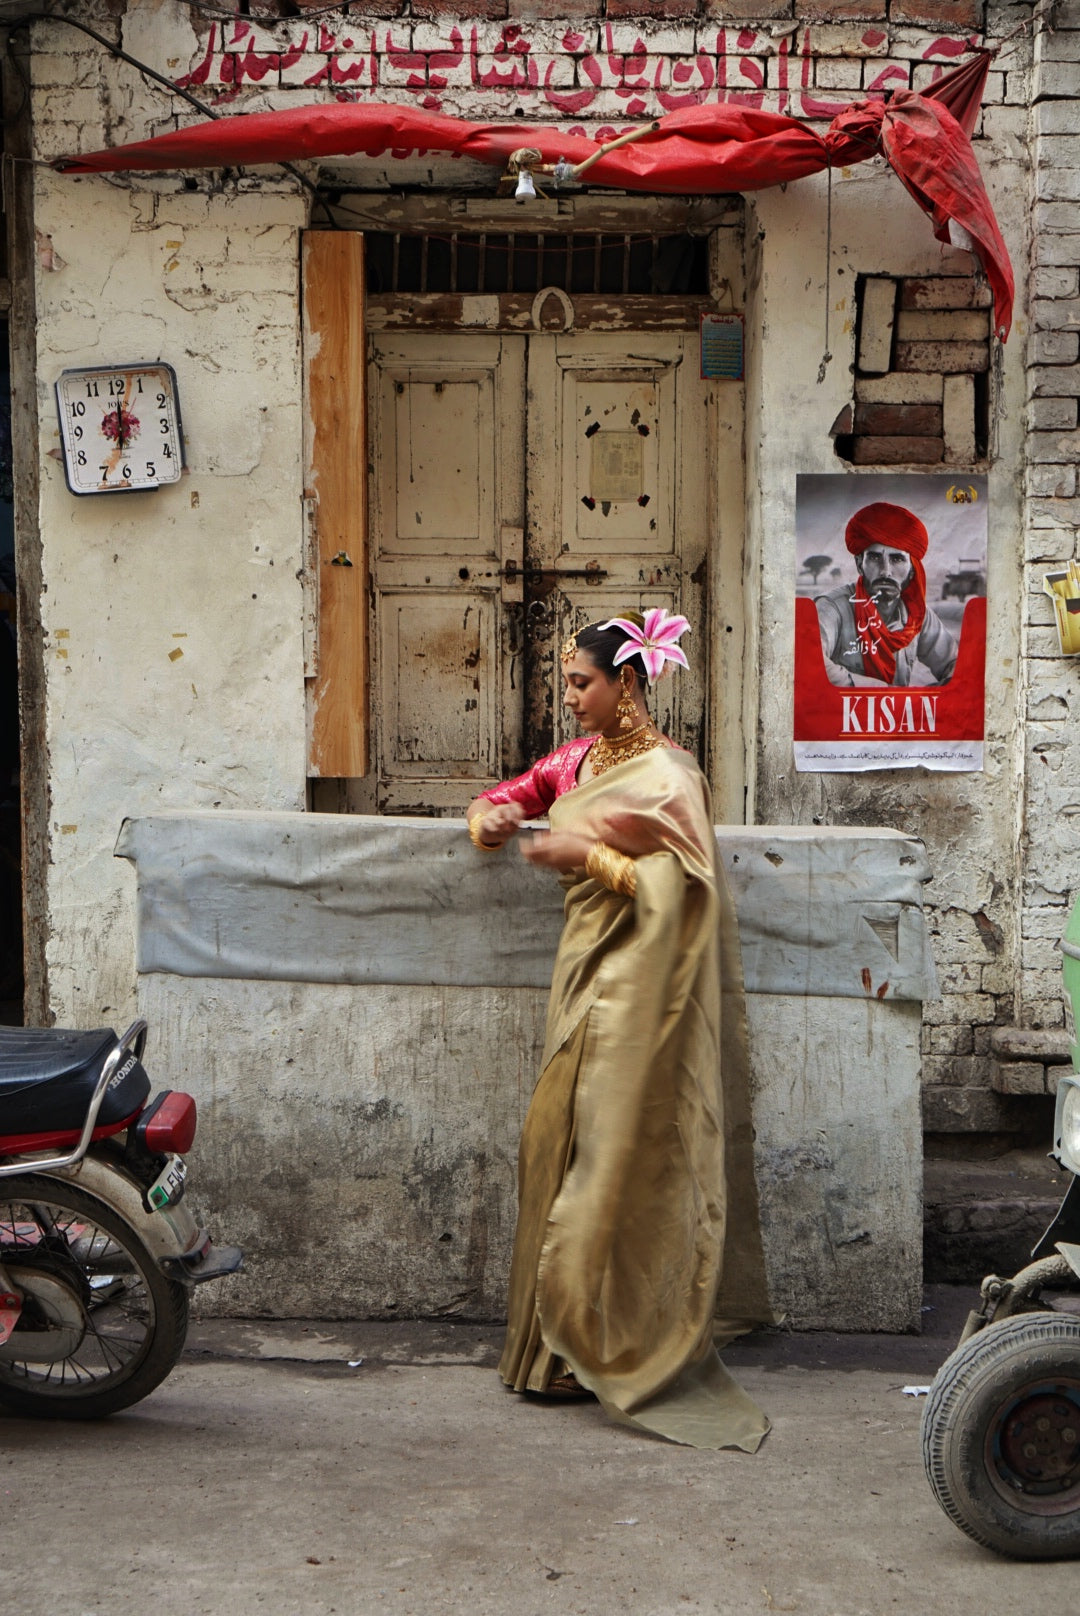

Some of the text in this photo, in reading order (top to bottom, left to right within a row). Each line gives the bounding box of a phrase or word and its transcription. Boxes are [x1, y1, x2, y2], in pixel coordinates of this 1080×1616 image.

[385, 24, 541, 111] شاپ
[86, 381, 99, 398] 11
[108, 379, 125, 396] 12
[136, 378, 144, 394] 1
[71, 401, 86, 417] 10
[156, 393, 167, 409] 2
[74, 425, 83, 441] 9
[160, 418, 170, 434] 3
[77, 450, 87, 466] 8
[162, 443, 172, 459] 4
[99, 465, 109, 482] 7
[122, 464, 132, 479] 6
[146, 461, 156, 478] 5
[848, 590, 882, 608] میرے
[857, 608, 882, 633] دیس
[843, 634, 882, 657] کا ذائقہ
[841, 695, 939, 733] KISAN
[109, 1055, 138, 1089] HONDA
